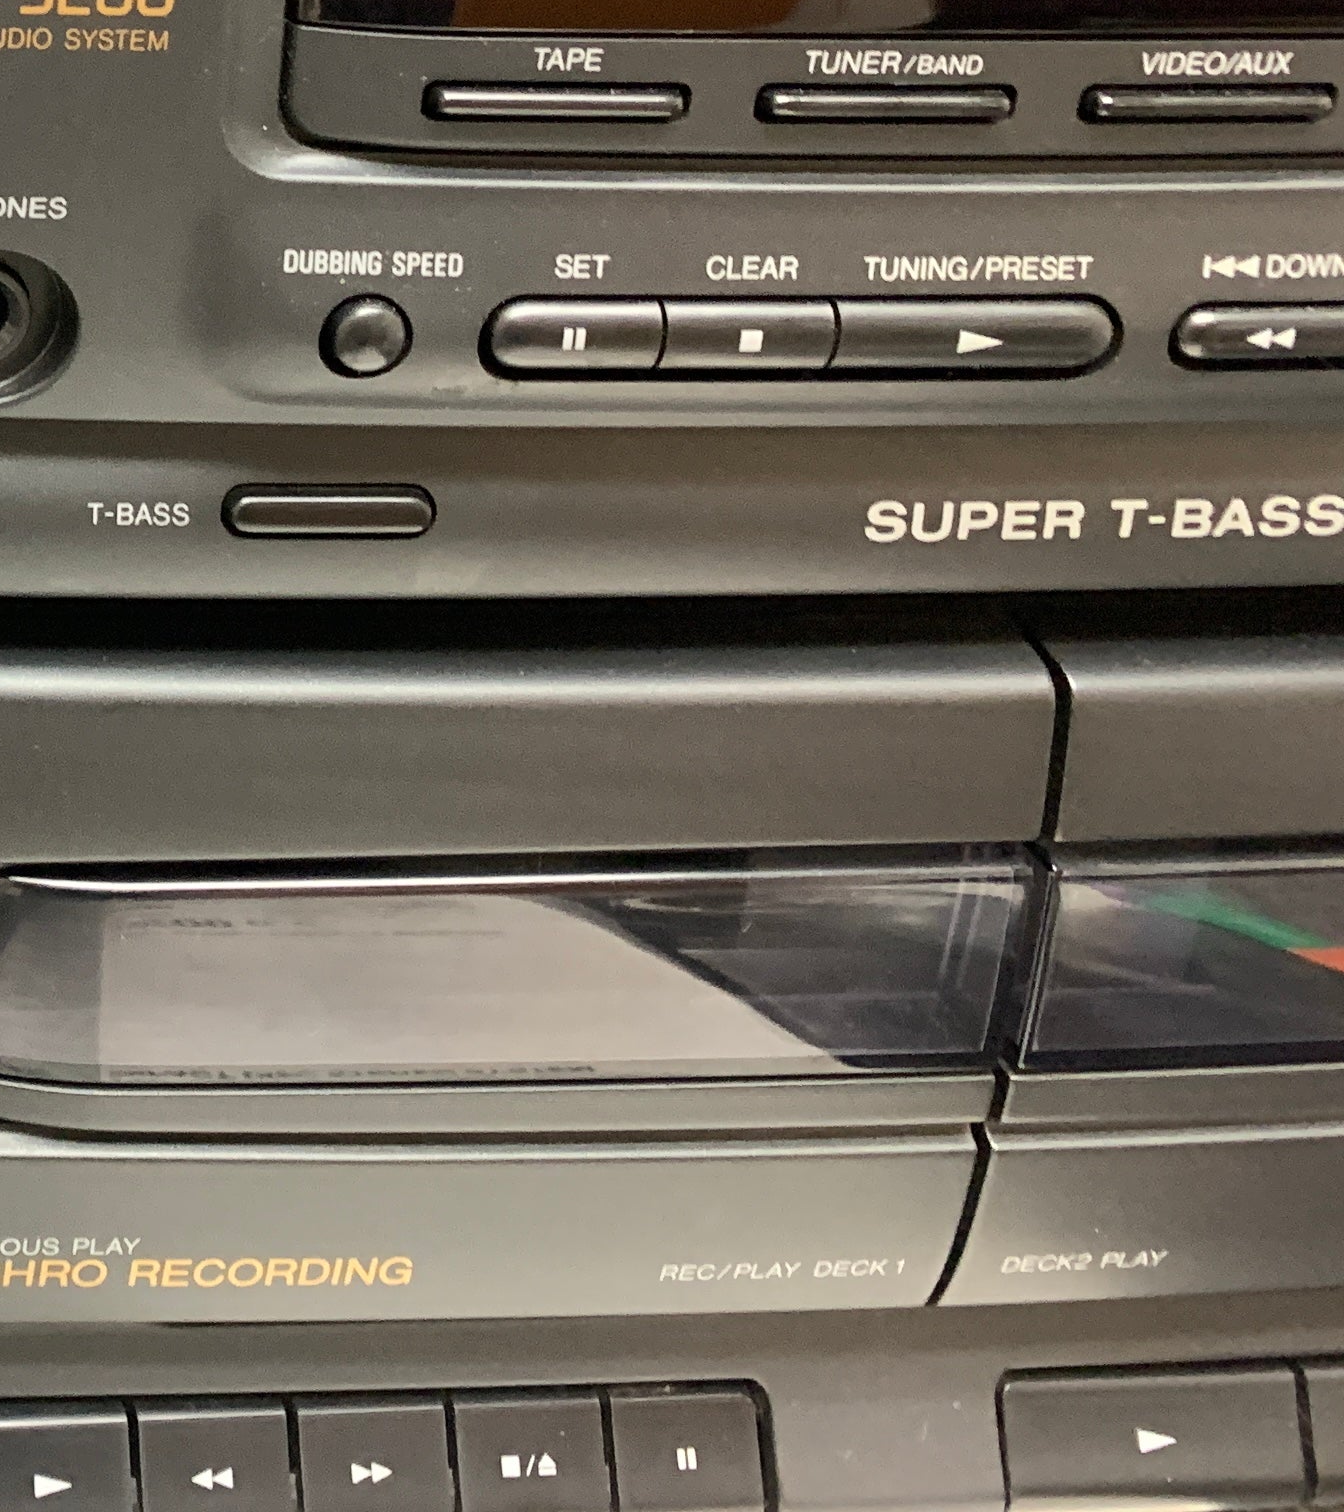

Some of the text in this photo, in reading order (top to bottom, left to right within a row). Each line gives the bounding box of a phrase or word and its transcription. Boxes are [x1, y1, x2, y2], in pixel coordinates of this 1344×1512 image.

[63, 29, 170, 52] SYSTEM
[533, 47, 604, 73] TAPE
[805, 49, 984, 76] TUNER/BAND
[1141, 51, 1293, 76] VIDEO/AUX
[283, 249, 464, 278] DUBBING SPEED
[553, 254, 609, 280] SET
[706, 255, 799, 280] CLEAR
[864, 255, 1093, 282] TUNING/PRESET
[87, 502, 190, 527] T-BASS
[864, 494, 1344, 543] SUPER T-BASS
[71, 1236, 141, 1257] PLAY
[128, 1257, 415, 1286] RECORDING
[659, 1261, 802, 1283] REC/PLAY
[813, 1259, 887, 1279] DECK
[1099, 1250, 1169, 1271] PLAY
